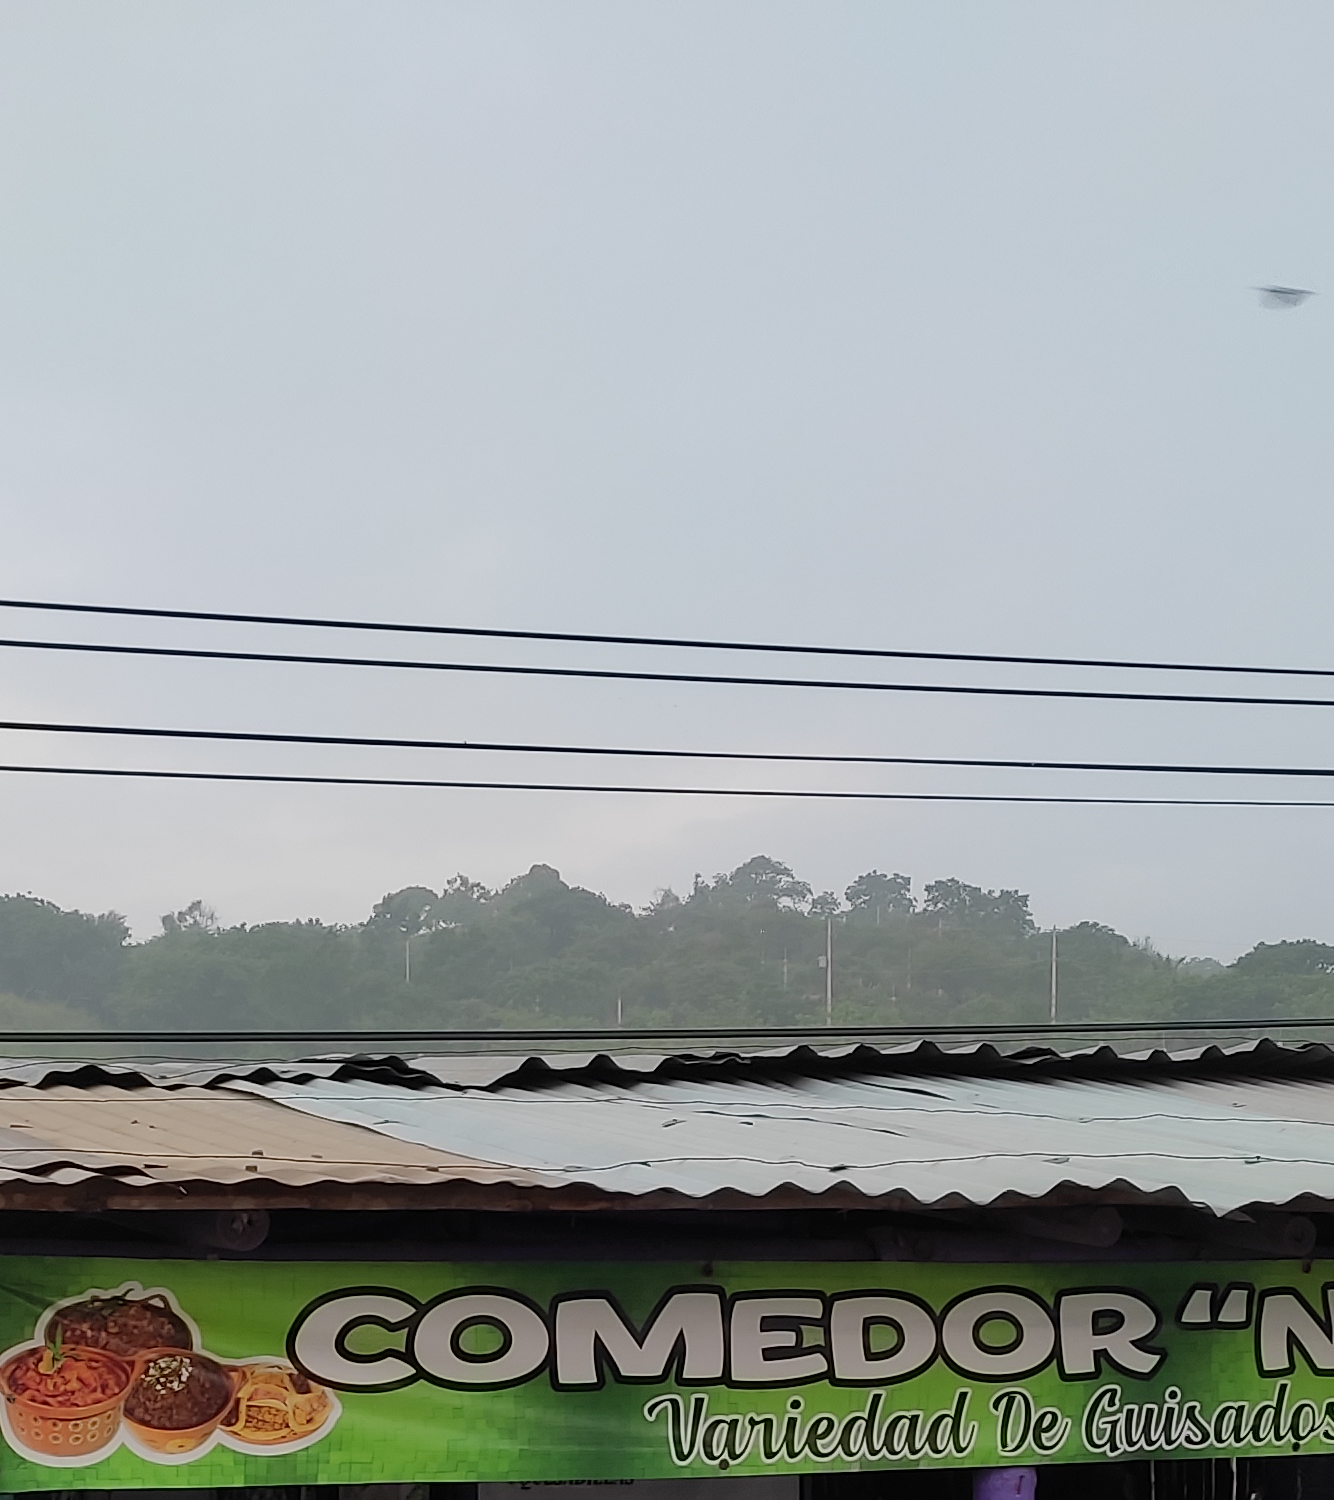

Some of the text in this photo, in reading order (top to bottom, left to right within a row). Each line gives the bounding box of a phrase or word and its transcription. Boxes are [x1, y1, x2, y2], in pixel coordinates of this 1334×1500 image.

[290, 1288, 1161, 1389] COMEDOR
[645, 1391, 977, 1464] Variedad
[992, 1388, 1069, 1453] De
